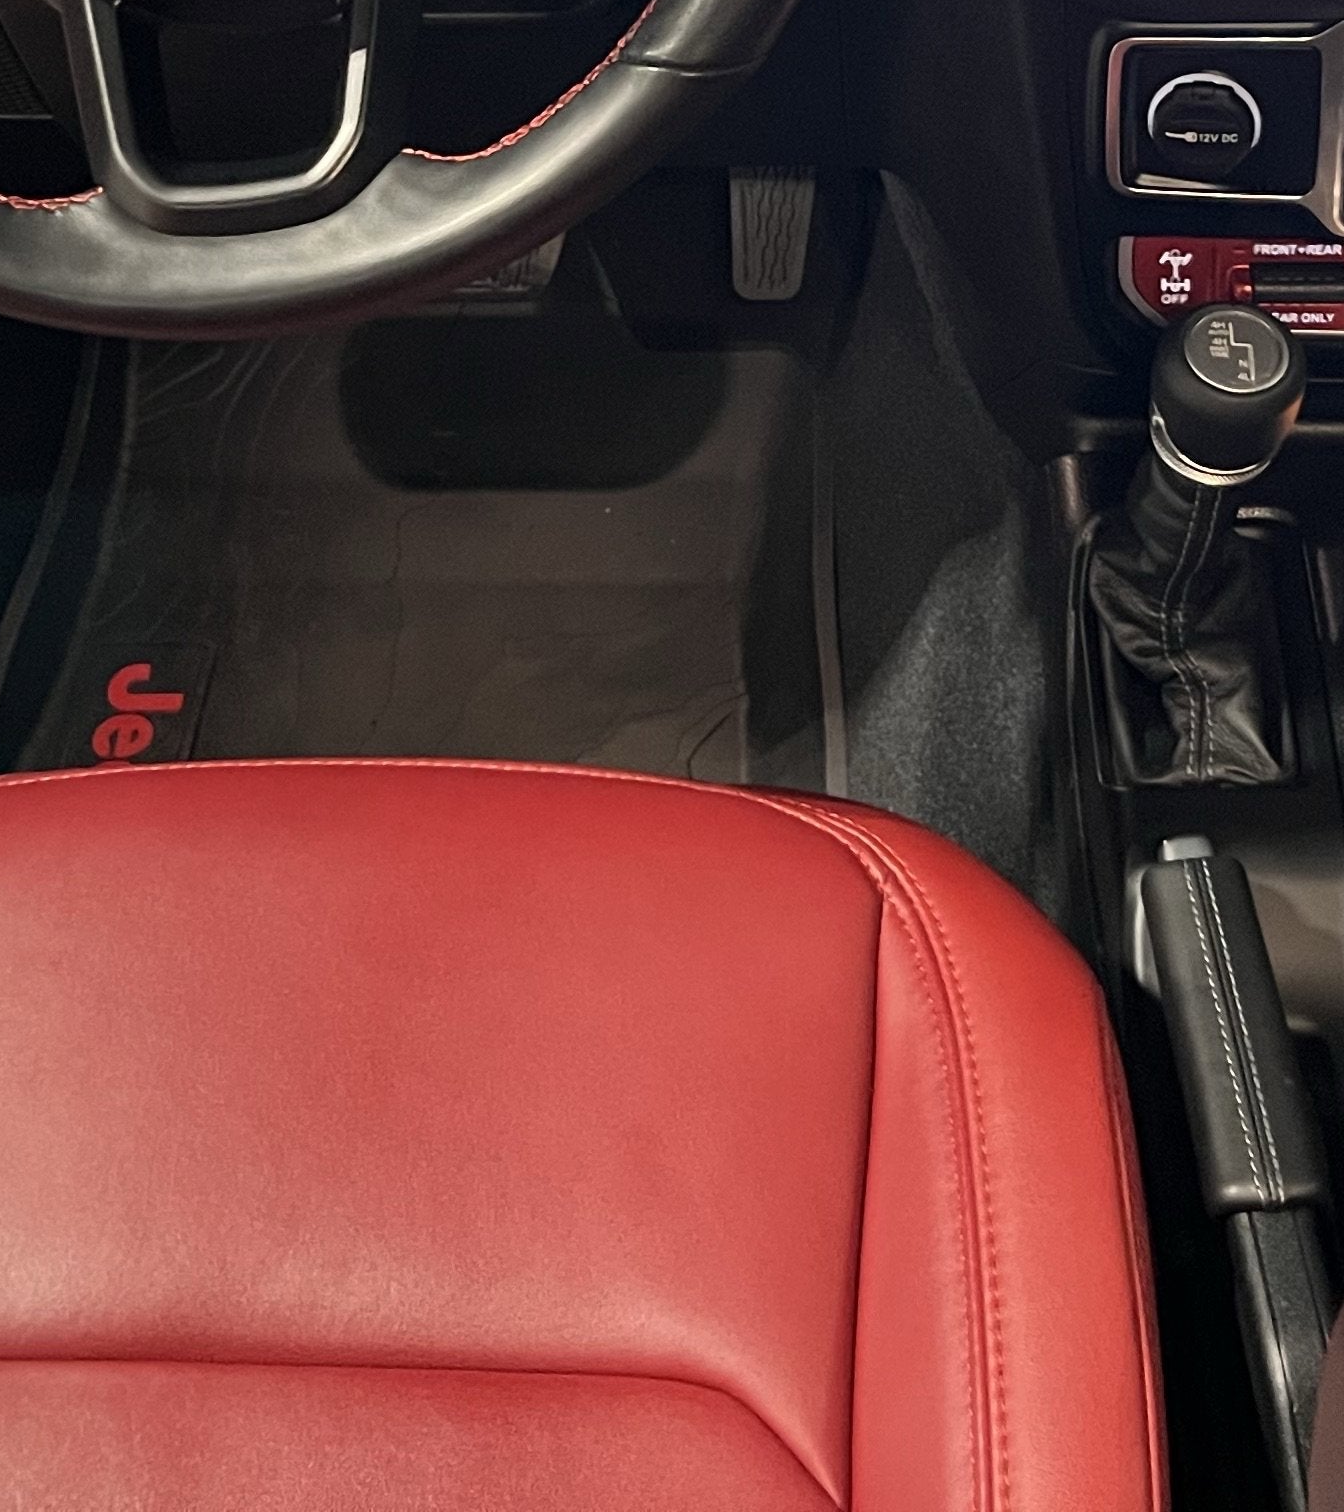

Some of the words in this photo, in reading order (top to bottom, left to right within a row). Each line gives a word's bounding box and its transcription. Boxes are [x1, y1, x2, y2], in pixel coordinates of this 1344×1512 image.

[1199, 133, 1219, 143] 12V
[1221, 133, 1239, 143] DC
[1160, 293, 1189, 305] OFF
[1300, 312, 1335, 323] ONLY
[92, 662, 185, 768] Je
